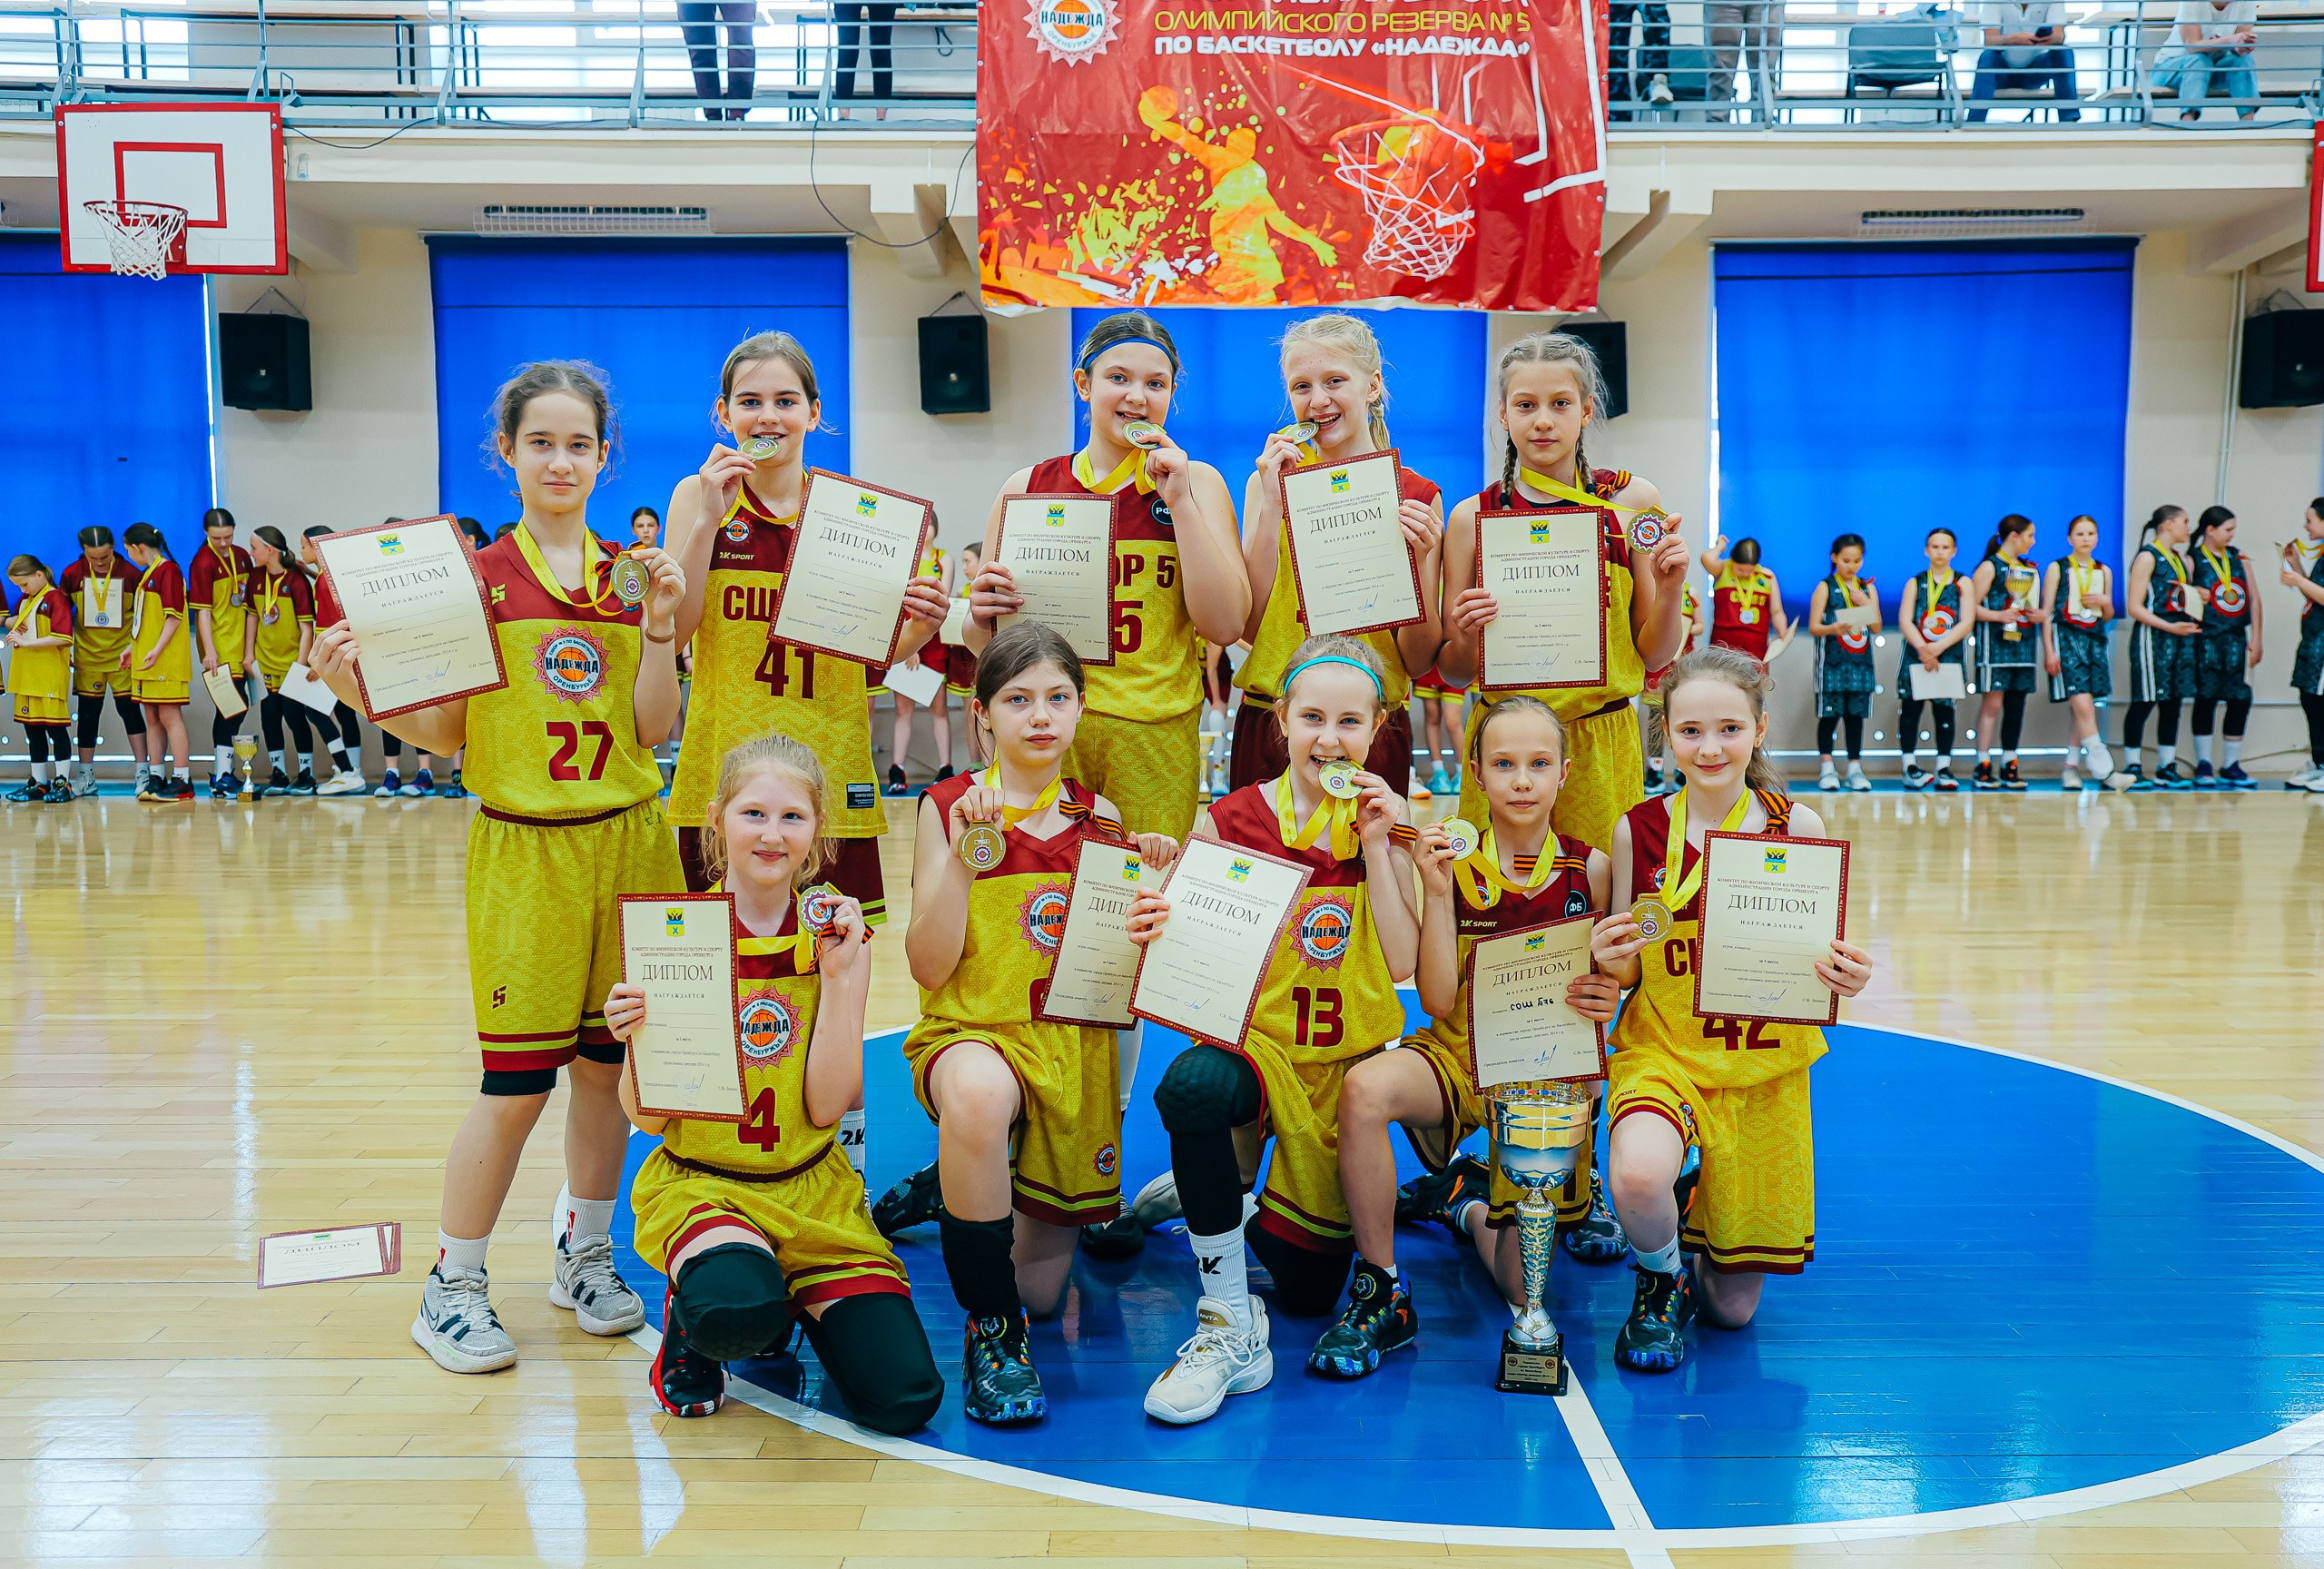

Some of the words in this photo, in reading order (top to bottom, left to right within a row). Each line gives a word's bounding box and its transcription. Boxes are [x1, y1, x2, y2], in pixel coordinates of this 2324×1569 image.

[1041, 11, 1103, 26] НАДЕЖДА
[1154, 10, 1366, 34] ОЛИМПИЙСКОГО
[1372, 10, 1485, 33] РЕЗЕРВА
[1154, 35, 1193, 55] ПО
[1196, 35, 1366, 58] БАСКЕТБОЛУ
[1371, 35, 1531, 59] «НАДЕЖДА»
[1310, 507, 1383, 534] ДИПЛОМ
[820, 527, 897, 558] ДИПЛОМ
[1324, 530, 1376, 544] НАГРАЖДАЕТСЯ
[828, 551, 882, 569] НАГРАЖДАЕТСЯ
[1016, 548, 1090, 562] ДИПЛОМ
[1157, 555, 1176, 588] 5
[1503, 565, 1580, 582] ДИПЛОМ
[361, 566, 450, 597] ДИПЛОМ
[382, 591, 444, 608] НАГРАЖДАЕТСЯ
[723, 585, 778, 623] СШ
[545, 657, 599, 674] НАДЕЖДА
[754, 640, 815, 700] 41
[553, 675, 593, 690] ОРЕНБУРЖЬЕ
[547, 720, 615, 780] 27
[1088, 896, 1131, 917] ДИПЛ
[1181, 891, 1262, 925] ДИПЛОМ
[1728, 895, 1817, 914] ДИПЛОМ
[1030, 914, 1063, 927] НАДЕЖ
[1096, 922, 1128, 932] НАГРАЖДА
[1187, 916, 1242, 936] НАГРАЖДАЕТСЯ
[1741, 920, 1803, 929] НАГРАЖДАЕТСЯ
[1302, 926, 1350, 939] НАДЕЖДА
[1307, 943, 1346, 957] ОРЕНБУРЖЬЕ
[641, 965, 714, 982] ДИПЛОМ
[1494, 960, 1572, 987] ДИПЛОМ
[1507, 982, 1562, 996] НАГРАЖДАЕТСЯ
[1291, 987, 1344, 1047] 13
[1702, 1018, 1781, 1051] 42
[741, 1038, 784, 1055] ОРЕНБУРЖЬЕ
[738, 1087, 781, 1153] 4
[1200, 1313, 1219, 1322] ANTA
